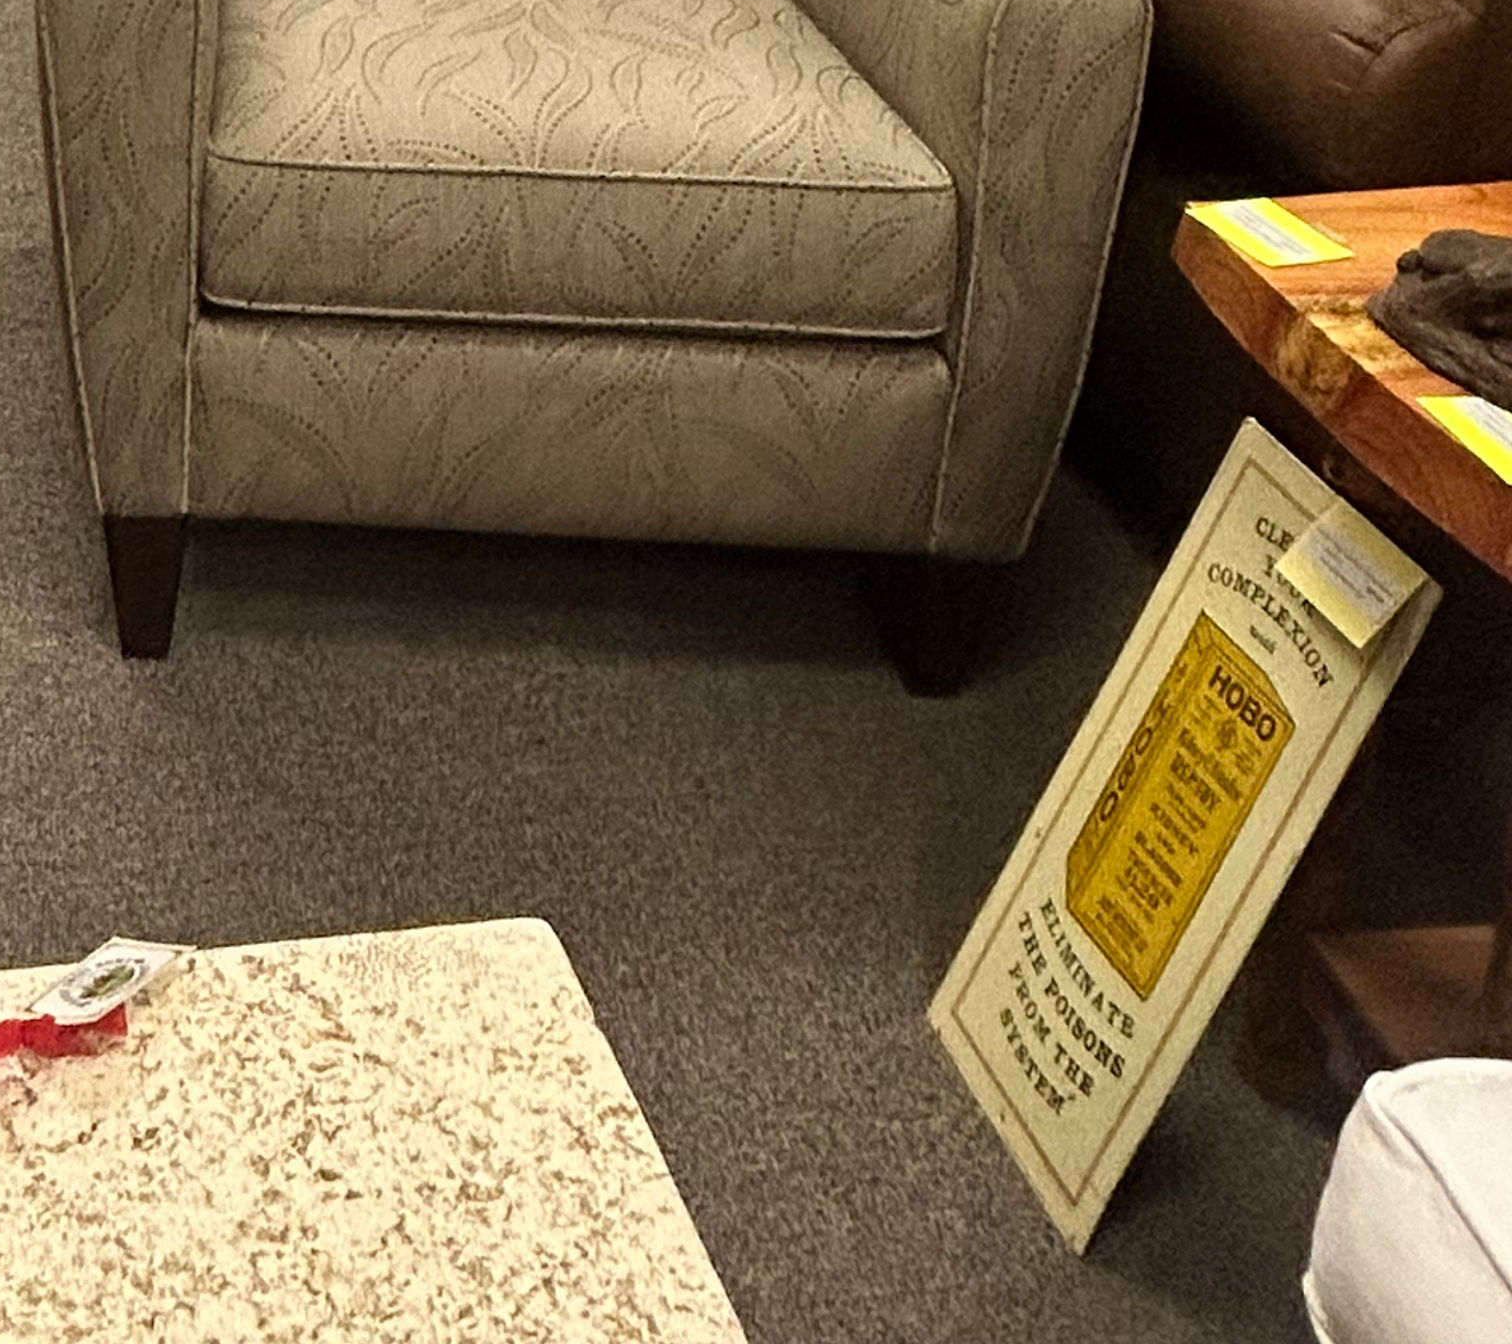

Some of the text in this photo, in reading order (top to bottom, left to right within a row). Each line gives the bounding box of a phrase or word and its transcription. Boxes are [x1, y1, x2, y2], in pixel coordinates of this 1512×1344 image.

[1255, 516, 1295, 552] CLE
[1208, 563, 1334, 688] COMPLEXION
[1208, 664, 1277, 742] HOBO
[1008, 961, 1094, 1097] FROM THE
[1018, 911, 1047, 976] THE
[1044, 976, 1126, 1079] POISONS
[1041, 896, 1135, 1039] ELIMINATE
[1000, 1008, 1065, 1116] SYSTEM
